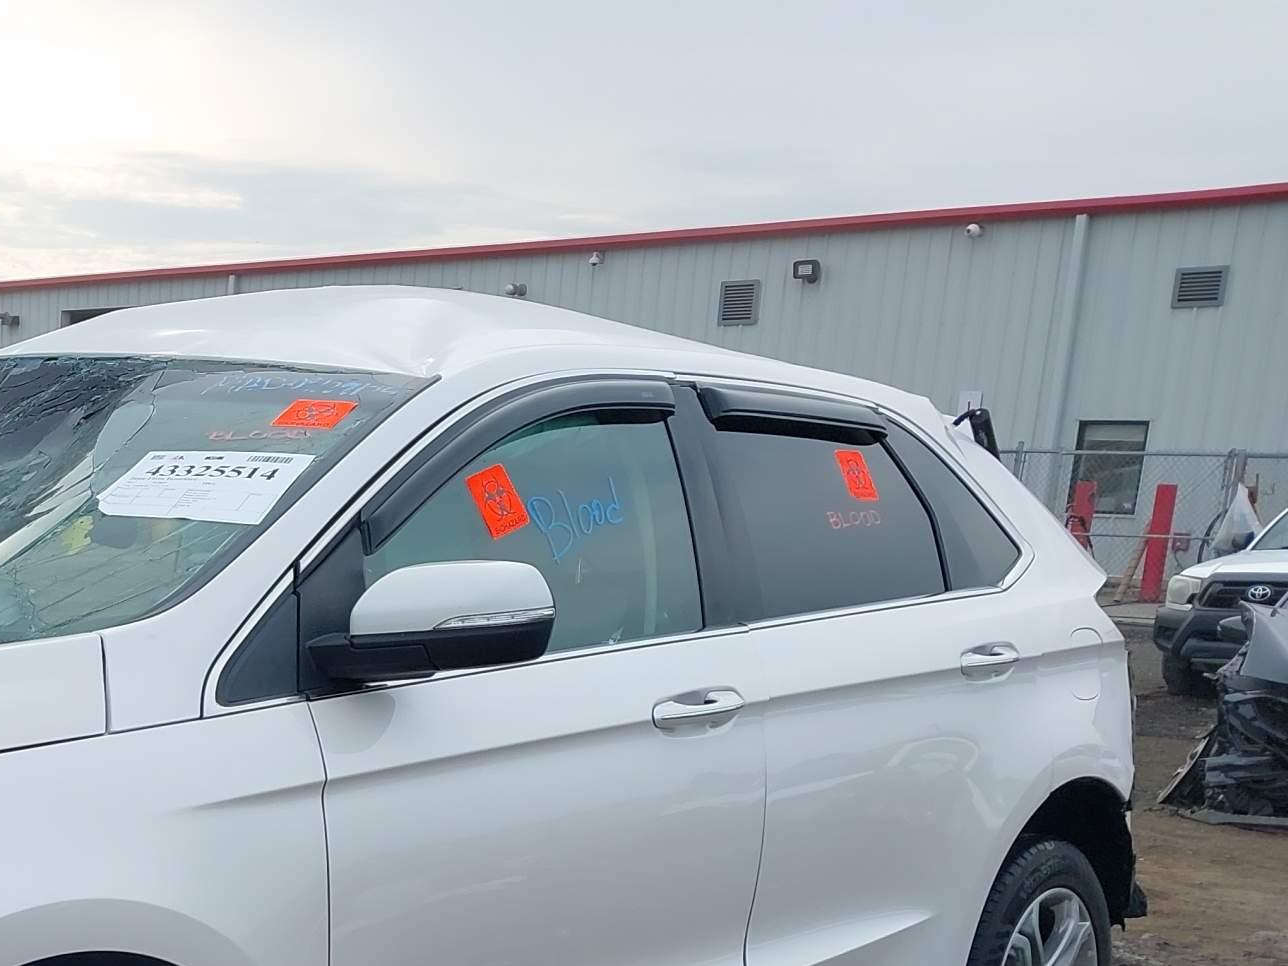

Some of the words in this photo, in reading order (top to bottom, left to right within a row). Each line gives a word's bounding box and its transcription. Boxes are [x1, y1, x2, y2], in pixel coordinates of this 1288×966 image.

[145, 464, 280, 481] 43325514
[527, 477, 623, 564] Blood
[826, 510, 881, 528] BLOOD
